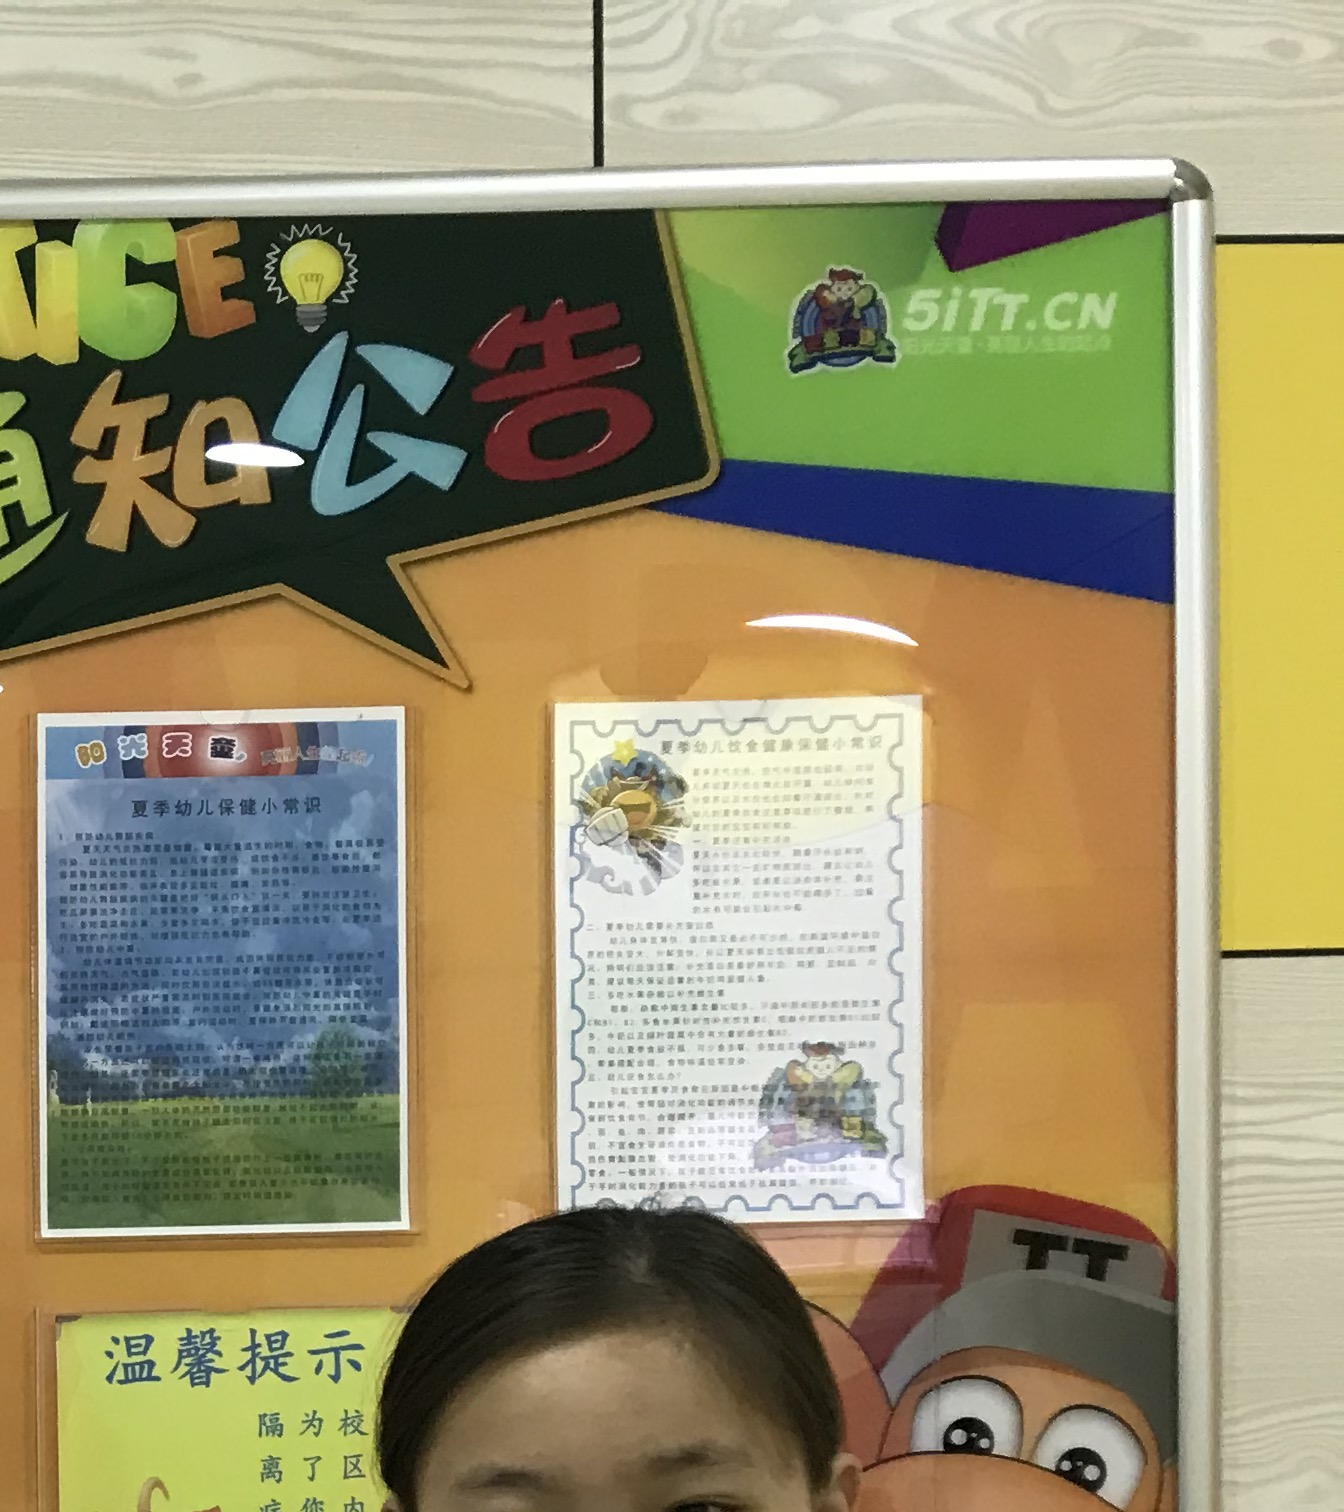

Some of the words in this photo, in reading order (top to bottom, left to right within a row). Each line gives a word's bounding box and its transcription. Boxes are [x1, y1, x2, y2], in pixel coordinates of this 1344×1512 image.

[131, 796, 323, 819] 夏季幼儿保健小常识
[1012, 1228, 1129, 1281] TT
[104, 1326, 366, 1389] 温馨提示
